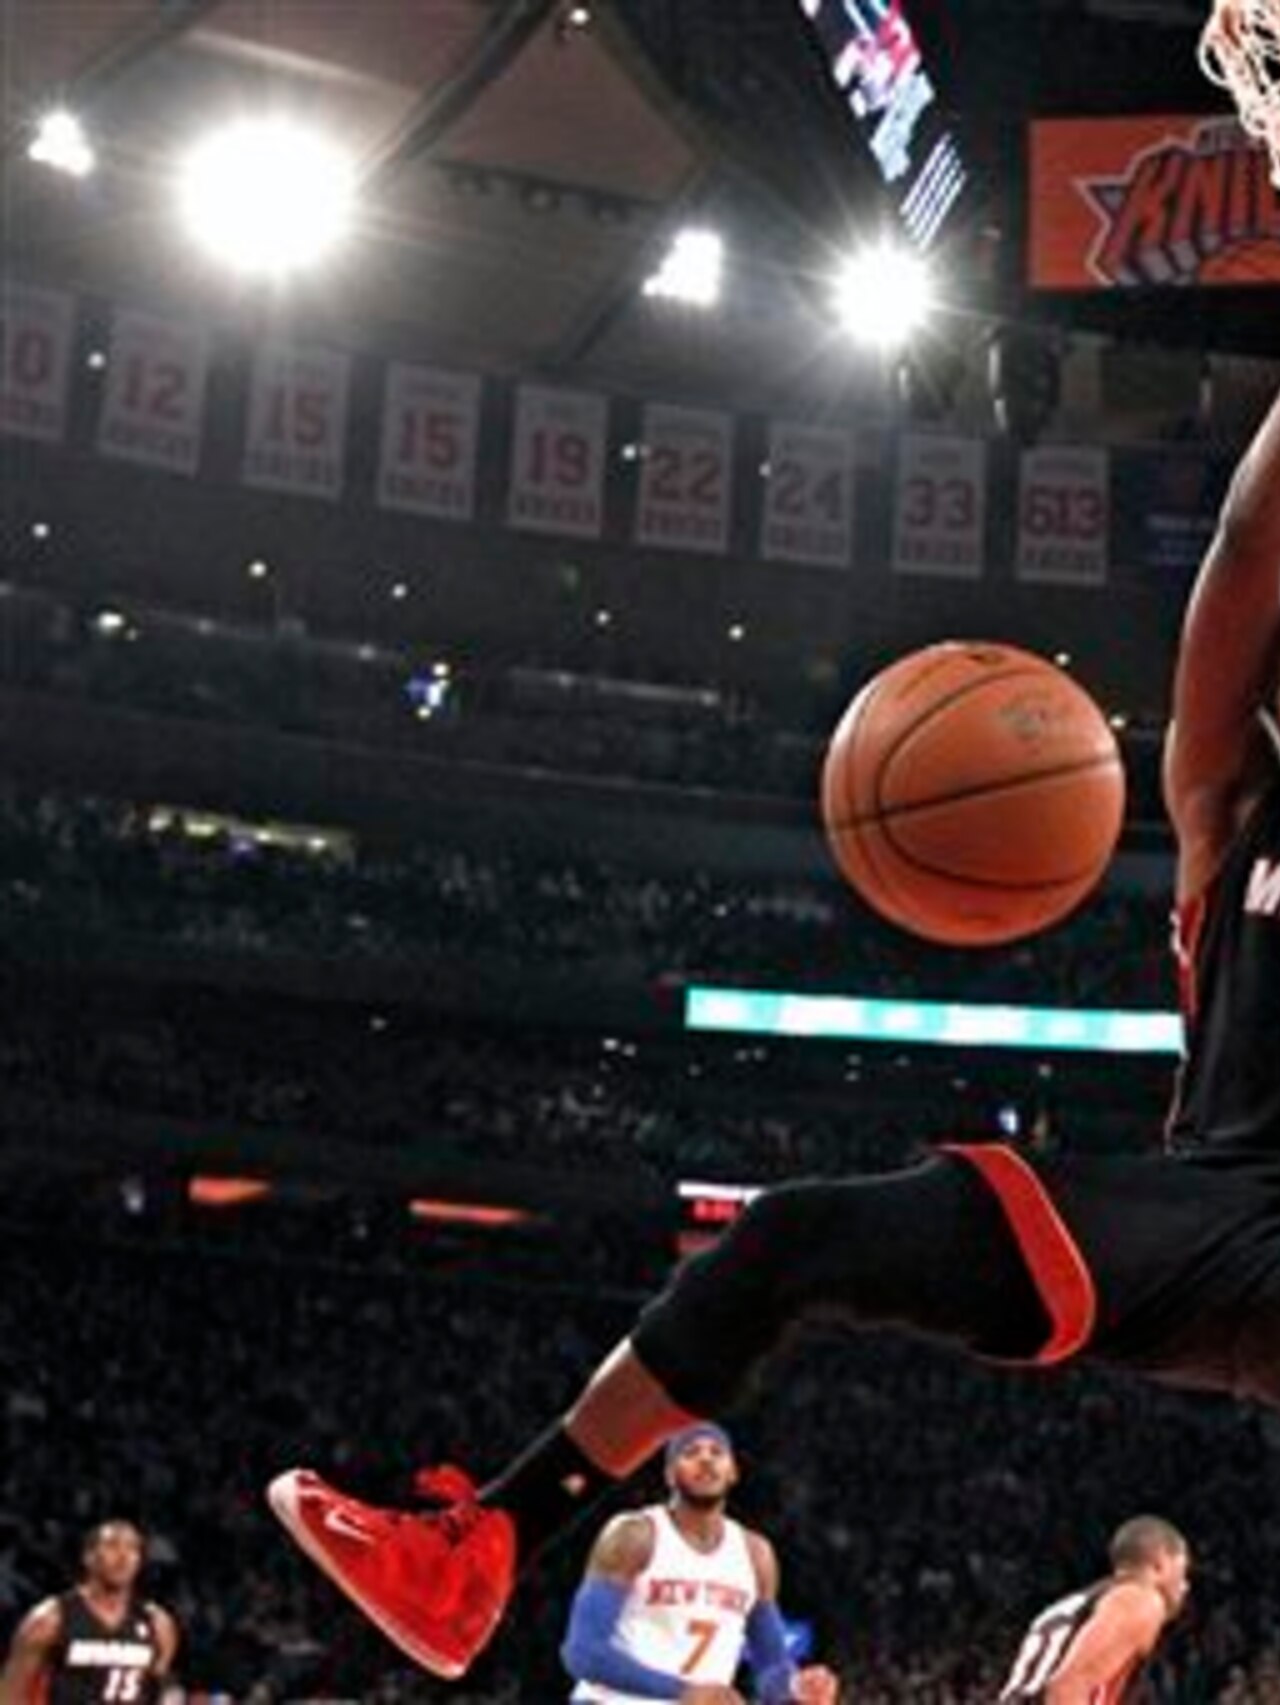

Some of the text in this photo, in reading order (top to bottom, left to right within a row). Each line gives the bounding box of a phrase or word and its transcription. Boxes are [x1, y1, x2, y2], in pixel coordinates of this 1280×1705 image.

[121, 351, 186, 421] 12
[266, 384, 330, 445] 15
[400, 412, 458, 469] 15
[529, 427, 591, 487] 19
[651, 443, 721, 504] 22
[774, 460, 842, 523] 24
[902, 477, 976, 529] 33
[1022, 484, 1105, 541] 613
[680, 1619, 720, 1675] 7
